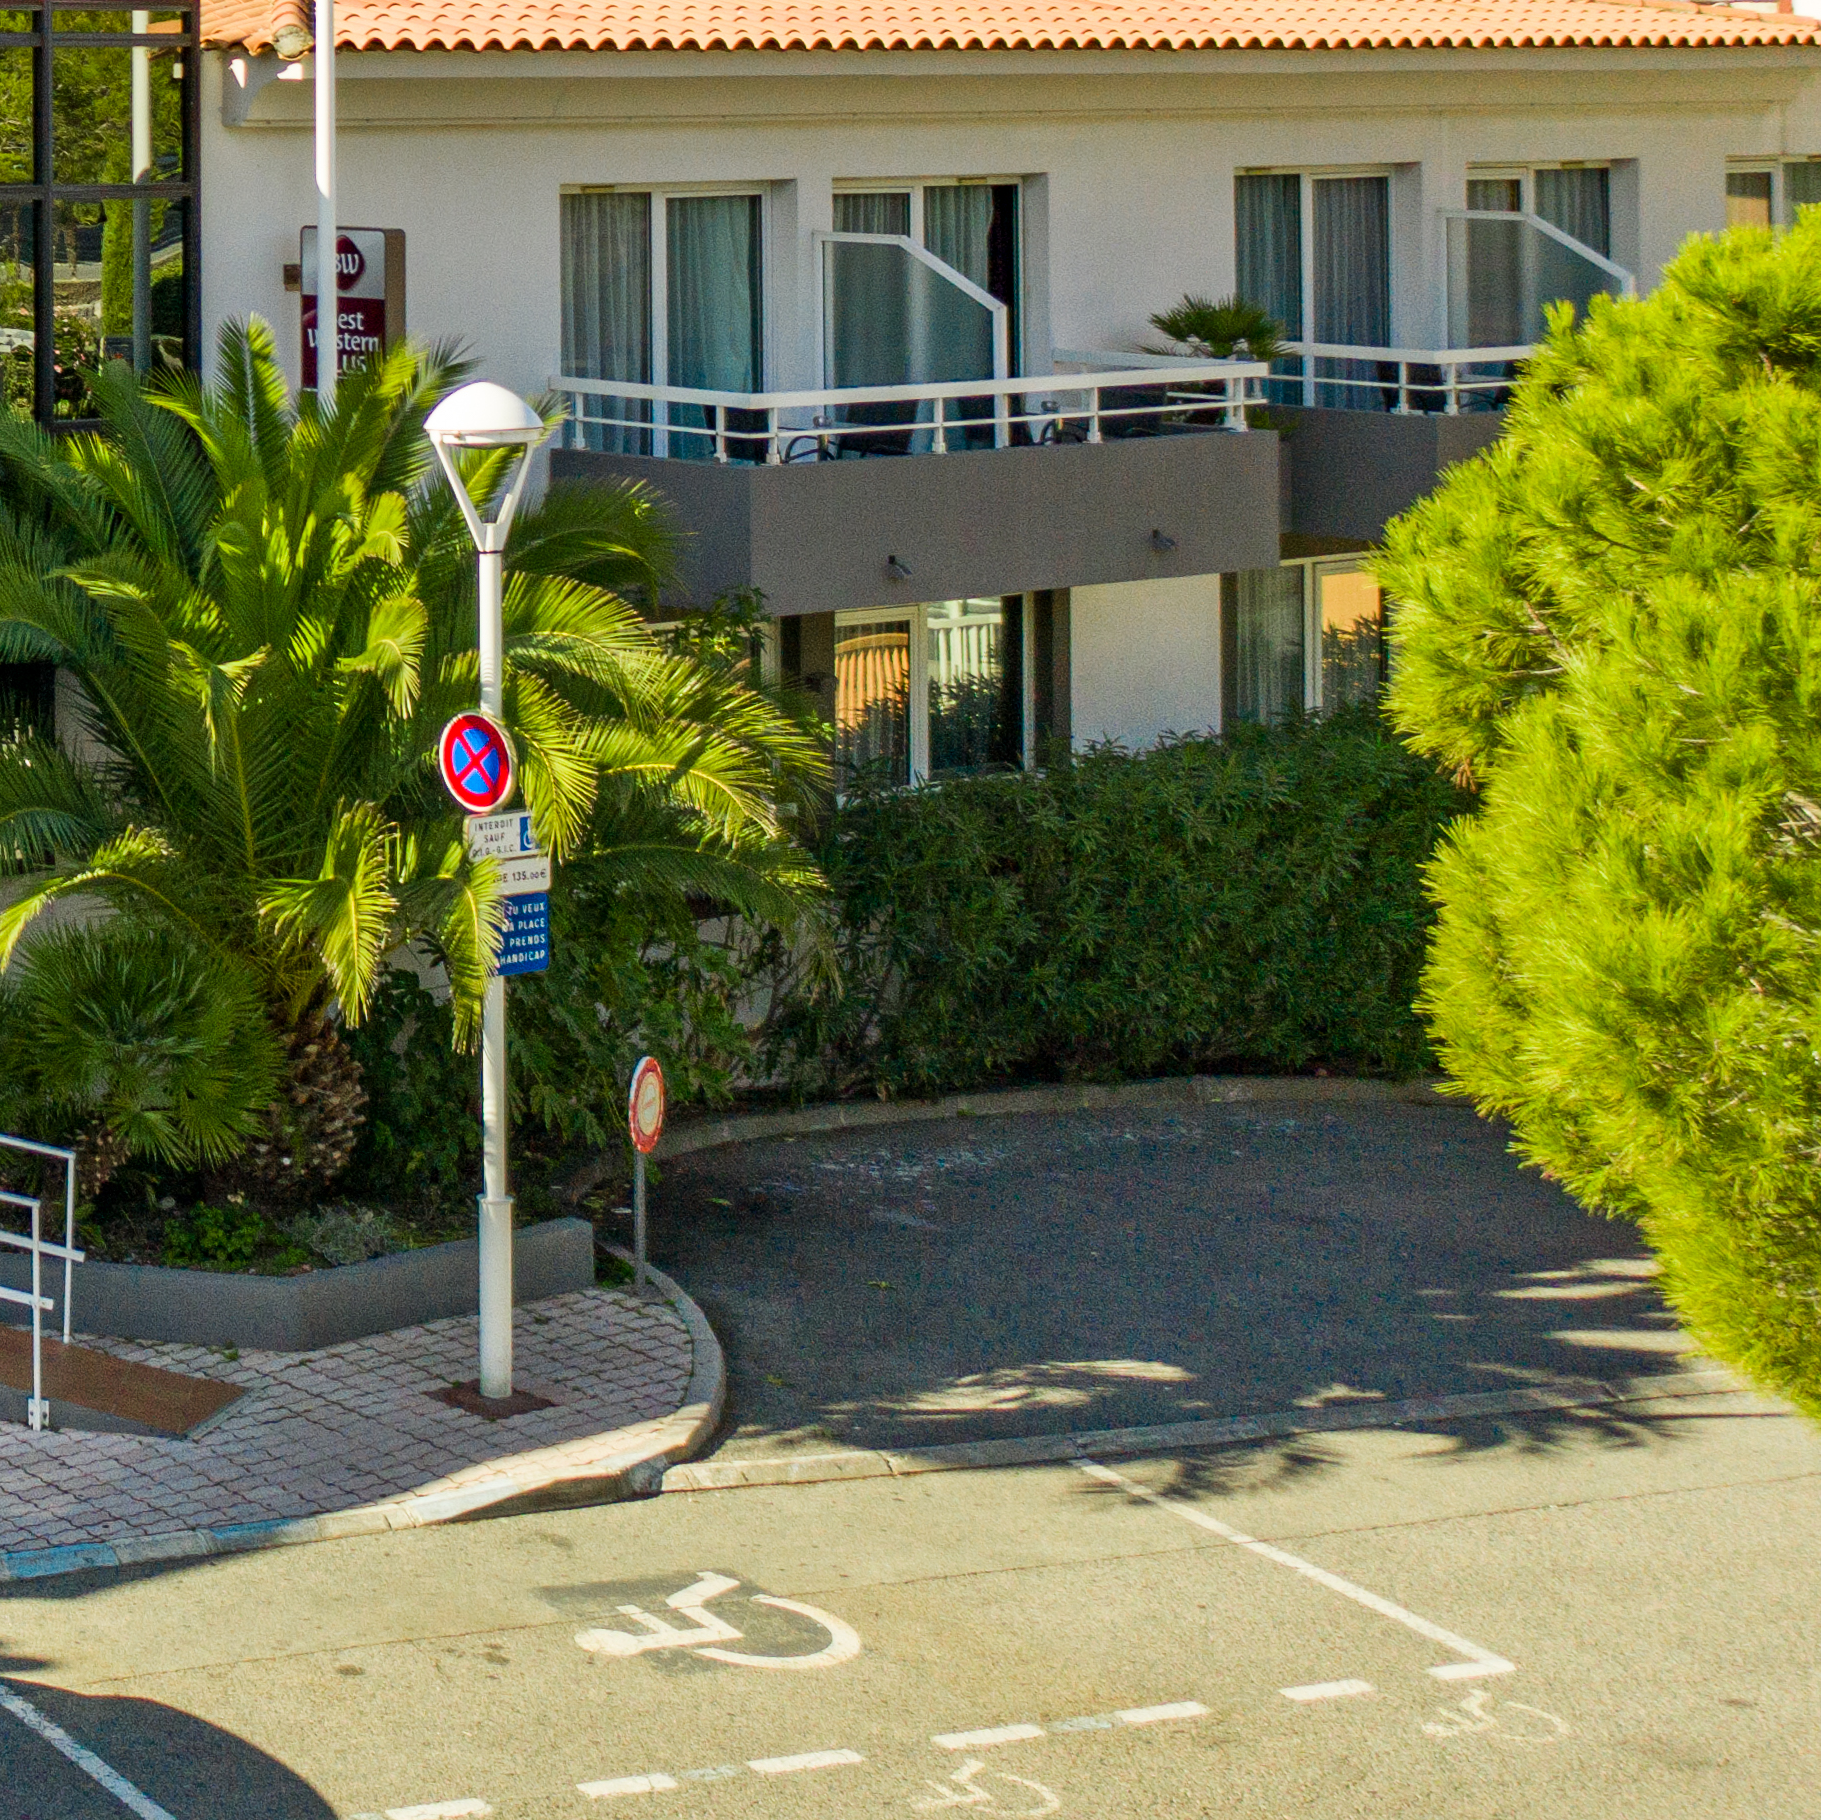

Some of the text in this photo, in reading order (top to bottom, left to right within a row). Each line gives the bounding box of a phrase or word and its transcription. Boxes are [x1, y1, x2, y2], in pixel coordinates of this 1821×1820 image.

[338, 312, 364, 331] est
[474, 818, 514, 832] INTERDIT
[483, 832, 505, 843] SAUF
[522, 901, 545, 914] VEUX
[518, 917, 546, 930] PLACE
[509, 933, 546, 948] PRENDS
[499, 949, 546, 965] HANDICAP
